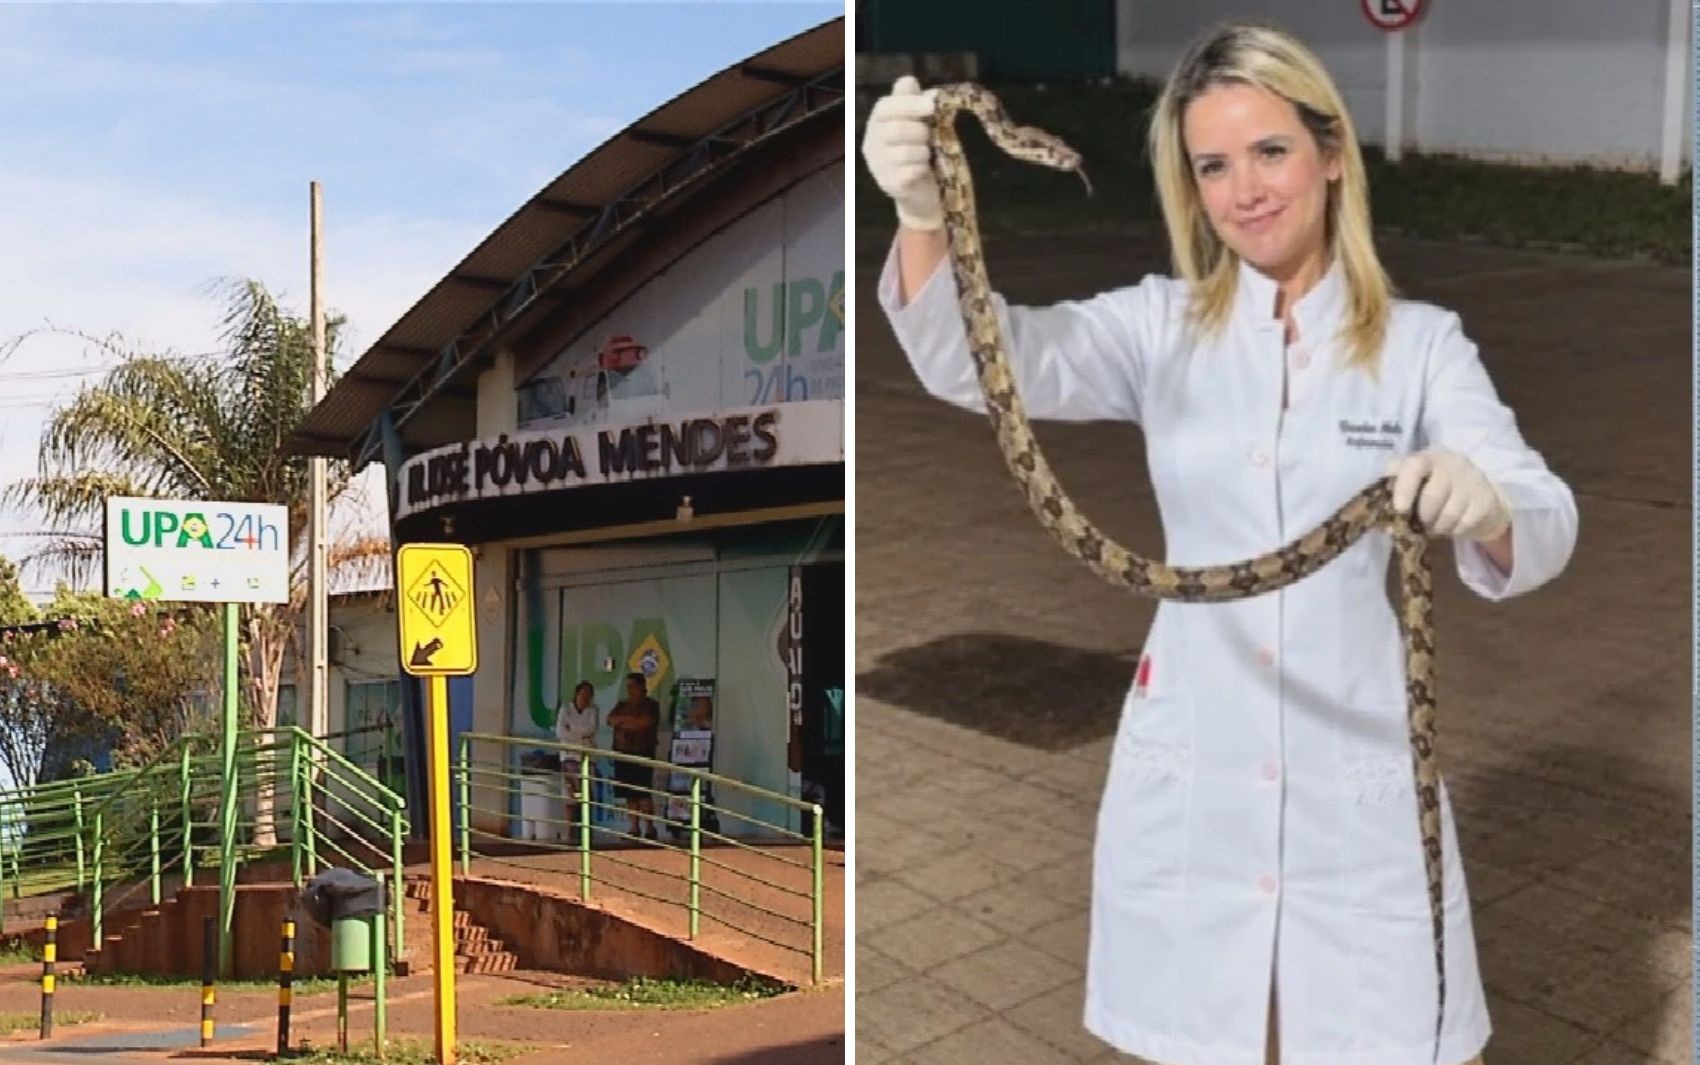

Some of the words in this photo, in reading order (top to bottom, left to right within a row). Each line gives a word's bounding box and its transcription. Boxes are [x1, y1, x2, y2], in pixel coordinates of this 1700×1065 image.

[475, 434, 586, 491] PÓVOA
[598, 411, 778, 475] MENDES
[527, 618, 676, 730] UPA
